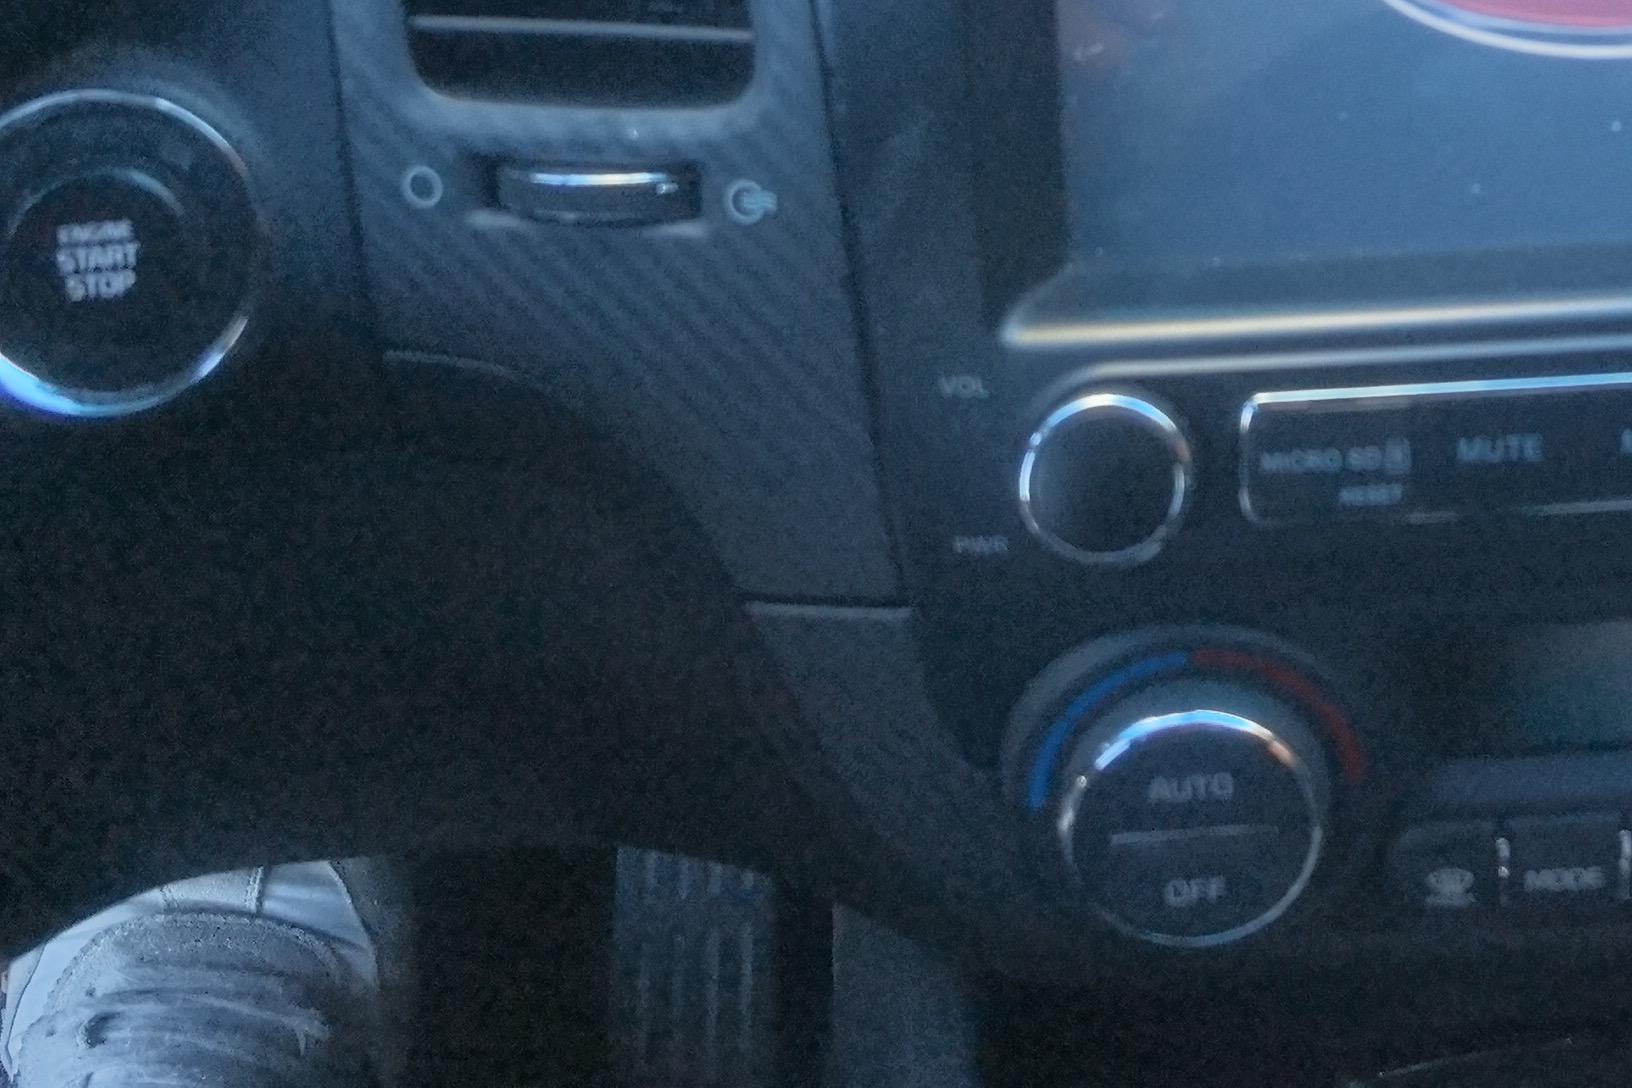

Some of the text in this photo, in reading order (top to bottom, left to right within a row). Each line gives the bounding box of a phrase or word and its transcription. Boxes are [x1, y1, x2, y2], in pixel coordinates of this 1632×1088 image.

[57, 241, 141, 273] START
[65, 268, 137, 302] STOP
[938, 375, 989, 398] VOL
[1260, 447, 1343, 473] MICRO
[1457, 433, 1544, 462] MUTE
[1149, 772, 1234, 802] AUTO
[1163, 876, 1227, 908] OFF
